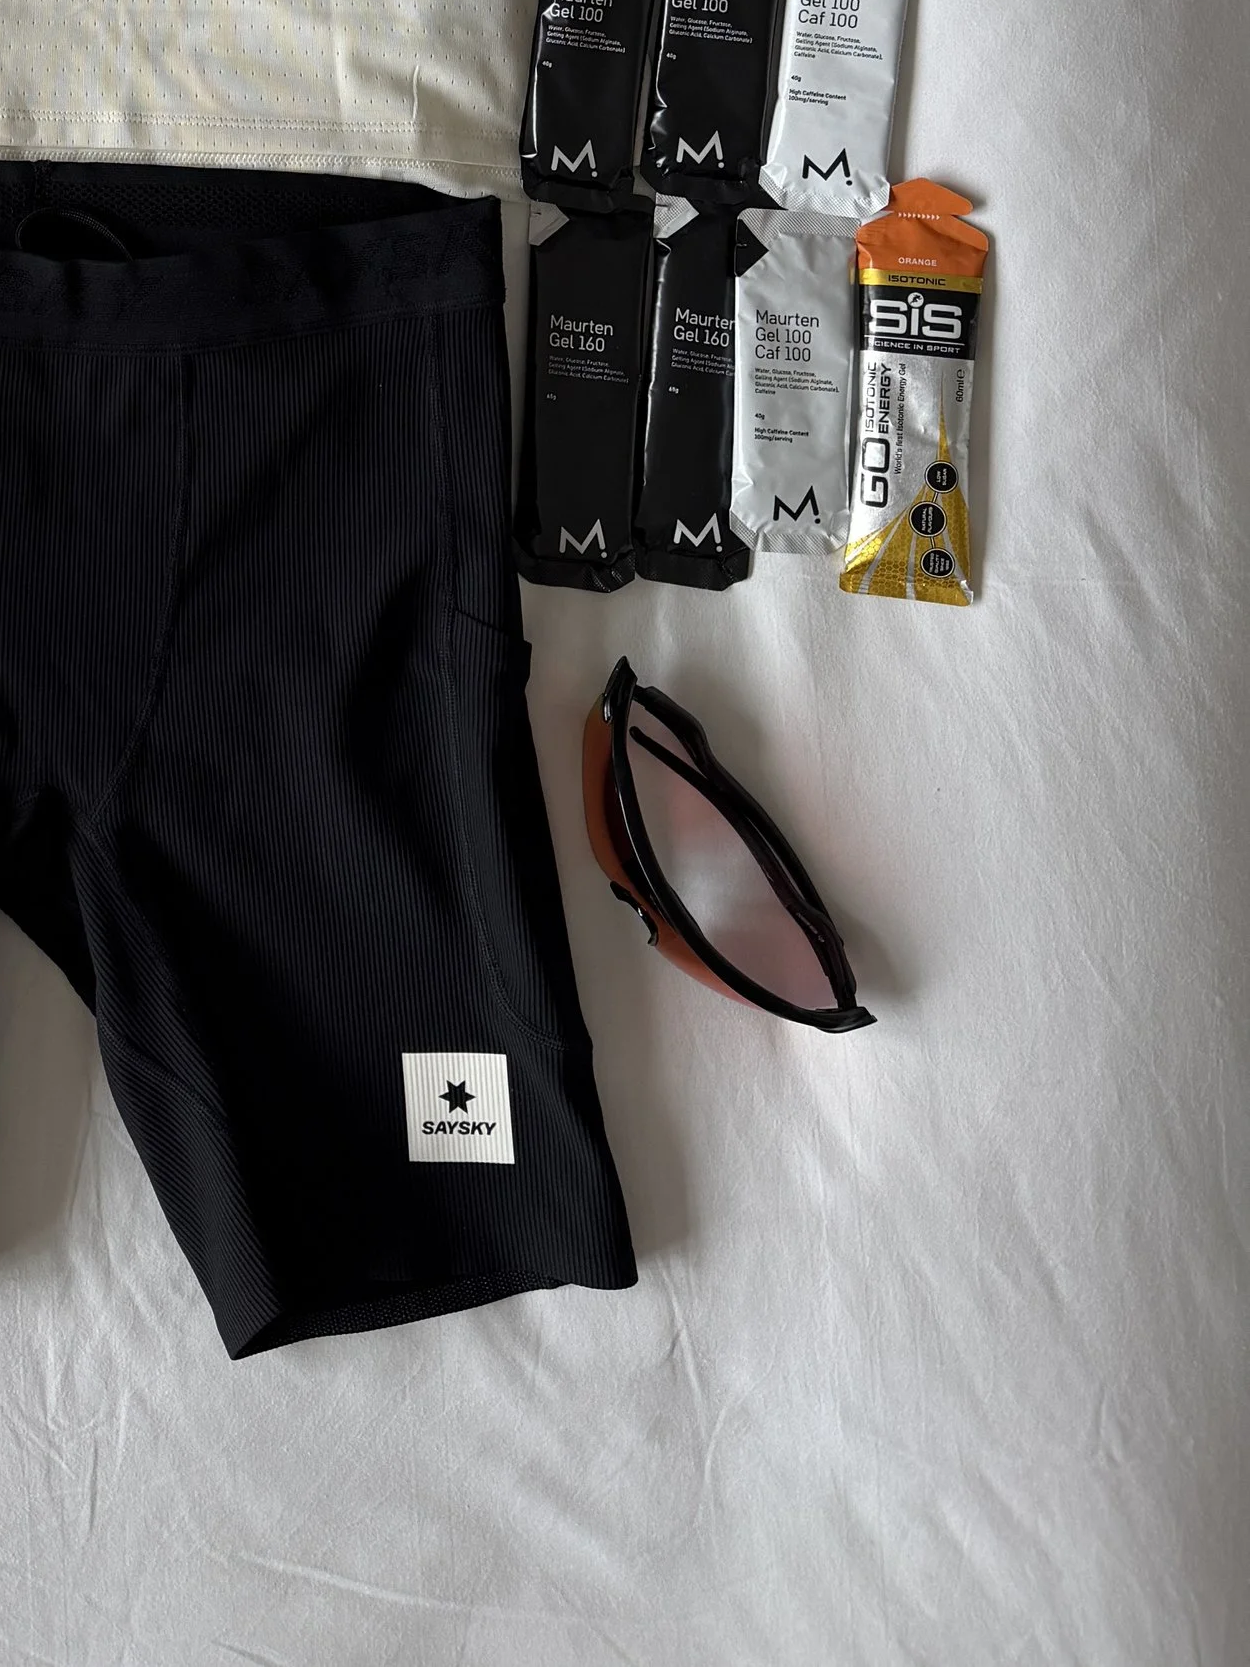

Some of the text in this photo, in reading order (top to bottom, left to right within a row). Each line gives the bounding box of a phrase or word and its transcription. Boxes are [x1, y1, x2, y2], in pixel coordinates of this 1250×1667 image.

[549, 3, 604, 23] Gel 100
[798, 9, 858, 29] Caf 100
[793, 51, 816, 59] Caffeine
[790, 75, 802, 83] 40g
[788, 95, 829, 106] 100mg/serving
[789, 88, 847, 101] High Caffeine Content
[897, 256, 938, 267] ORANGE
[888, 274, 947, 286] ISOTONIC
[550, 314, 614, 337] Maurten
[755, 309, 820, 328] Maurten
[549, 332, 605, 352] Gel 160
[673, 325, 730, 347] Gel 160
[755, 326, 812, 345] Gel 100
[754, 344, 811, 363] Caf 100
[913, 343, 924, 351] IN
[926, 345, 961, 354] SPORT
[865, 361, 877, 433] ISOTONIC
[878, 362, 892, 435] ENERGY
[898, 377, 907, 402] Energy
[956, 380, 965, 403] 60ml
[897, 403, 905, 432] Isotonic
[754, 434, 793, 443] 100mg/serving
[767, 428, 788, 436] Caffeine
[788, 429, 810, 437] Content
[894, 448, 903, 475] World's
[860, 437, 891, 509] GO
[421, 1120, 497, 1136] SAYSKY
